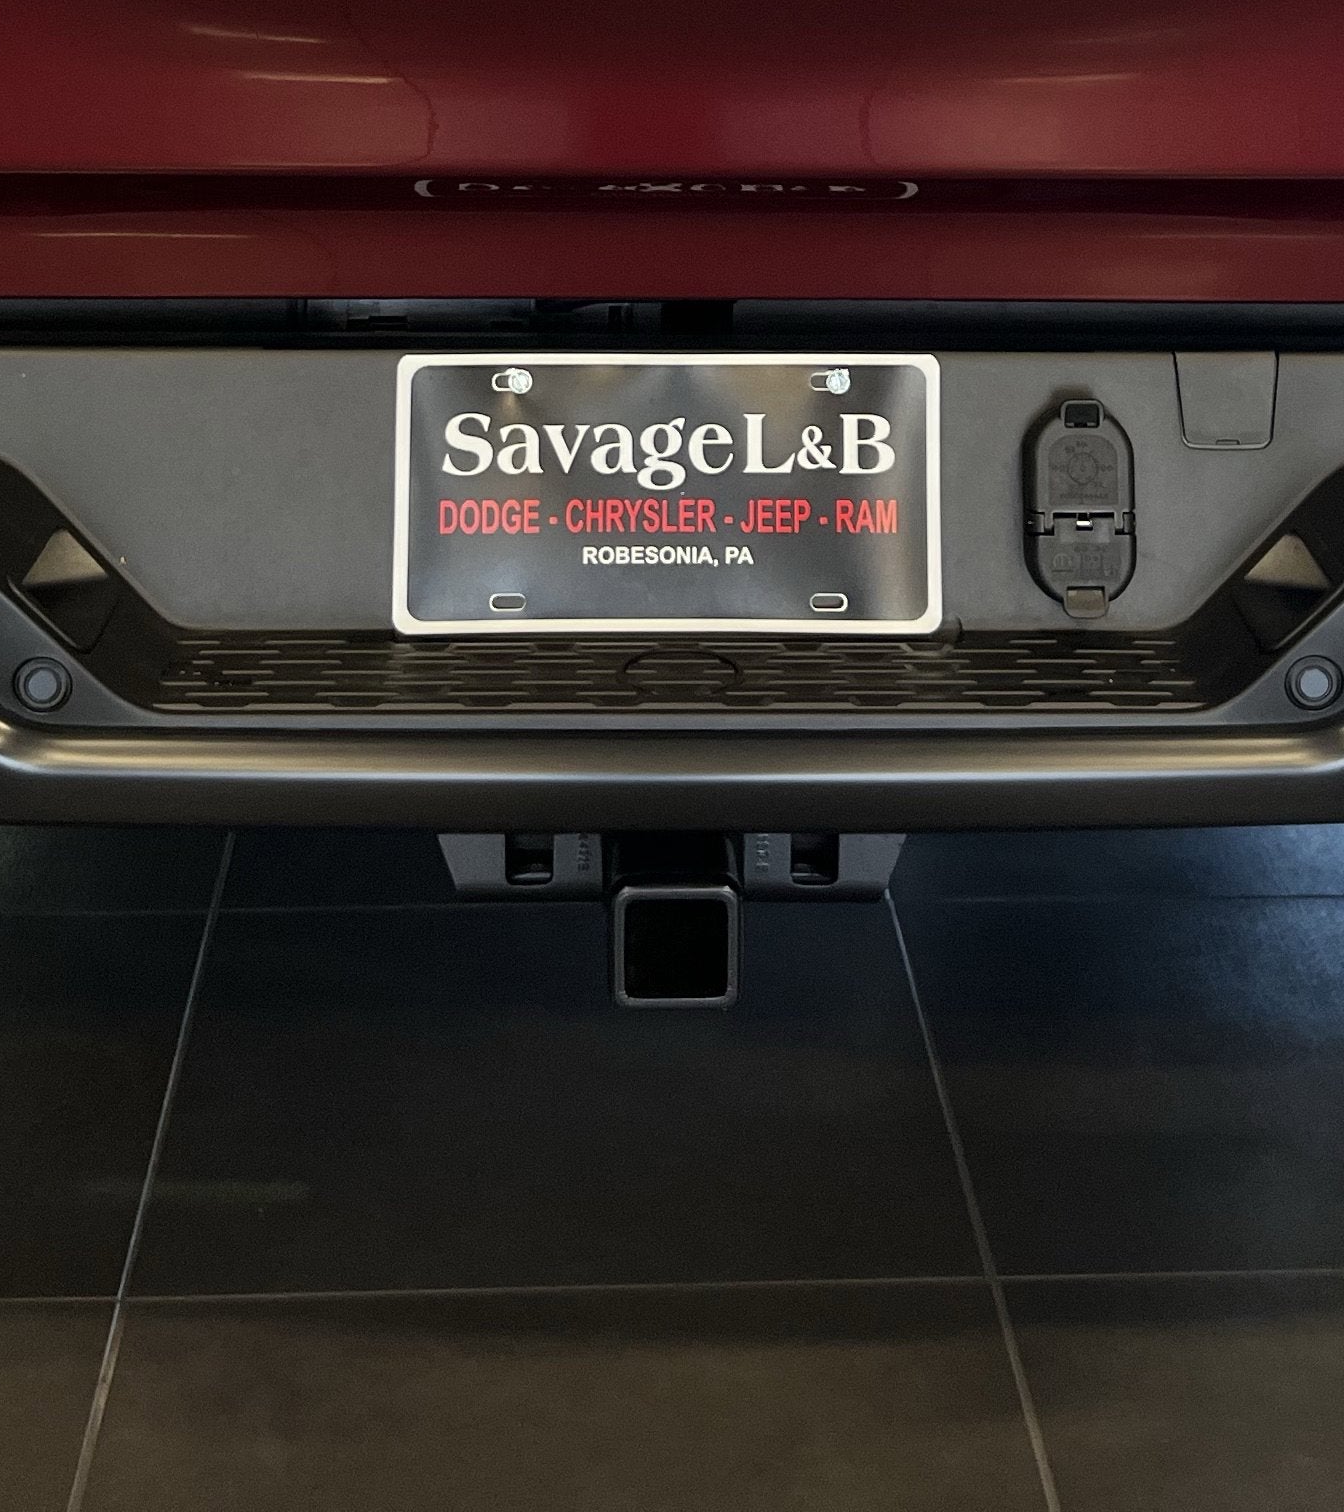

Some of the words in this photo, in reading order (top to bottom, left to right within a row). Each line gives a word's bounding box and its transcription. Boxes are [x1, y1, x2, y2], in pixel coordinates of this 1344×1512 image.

[439, 499, 541, 535] DODGE
[565, 498, 717, 534] CHRYSLER
[739, 498, 812, 534] JEEP
[835, 498, 898, 534] RAM
[582, 546, 719, 568] ROBESONIA,
[725, 546, 755, 565] PA
